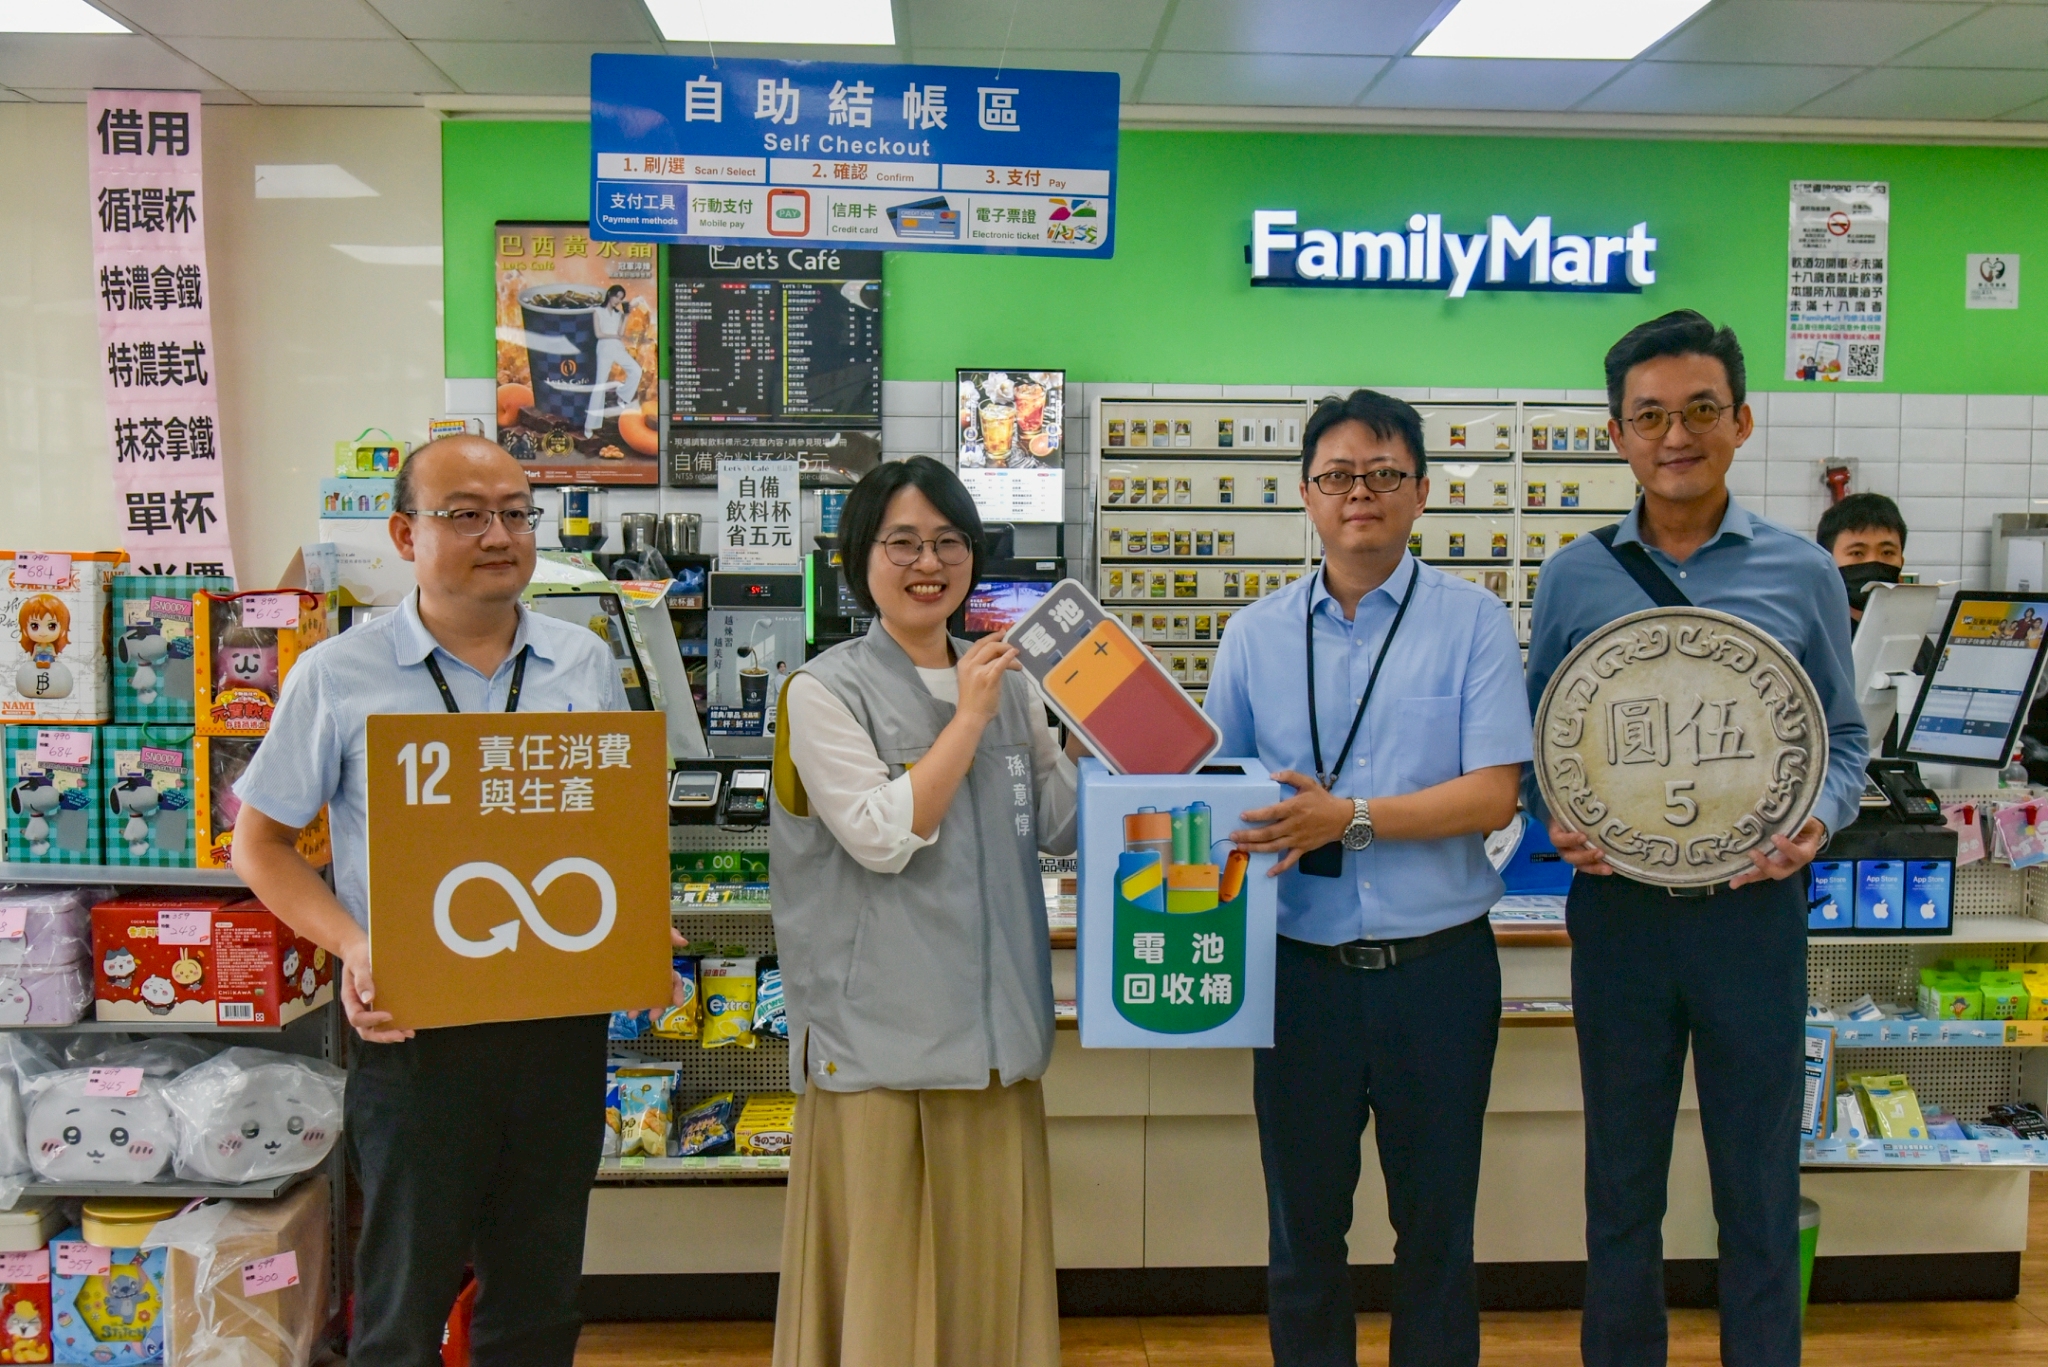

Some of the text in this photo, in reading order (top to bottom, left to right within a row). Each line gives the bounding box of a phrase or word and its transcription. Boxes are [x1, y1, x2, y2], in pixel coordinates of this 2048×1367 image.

[684, 74, 1021, 132] 自助結帳區
[96, 108, 190, 157] 借用
[763, 132, 930, 157] Self Checkout
[623, 157, 638, 172] 1.
[694, 165, 719, 176] Scan
[726, 166, 756, 177] Select
[811, 162, 915, 183] 2. 確認 Confirm
[985, 169, 1067, 190] 3. 支付 Pay
[98, 187, 197, 234] 循環杯
[609, 192, 676, 211] 支付工具
[691, 197, 754, 215] 行動支付
[831, 202, 878, 219] 信用卡
[602, 214, 679, 226] Payment methods
[699, 219, 745, 230] Mobile pay
[778, 209, 799, 218] PAY
[976, 207, 1037, 225] 電子票證
[831, 225, 879, 234] Credit card
[972, 229, 1040, 241] Electronic ticket
[500, 234, 652, 258] 巴西黃水晶
[1251, 209, 1658, 299] FamilyMart
[709, 244, 841, 271] Let's Café
[101, 264, 203, 312] 特濃拿鐵
[108, 341, 208, 388] 特濃美式
[115, 416, 216, 464] 抹茶拿鐵
[739, 475, 780, 498] 自備
[126, 490, 217, 536] 單杯
[726, 500, 792, 523] 飲料杯
[726, 524, 792, 547] 省五元
[27, 565, 54, 579] 684
[154, 600, 188, 613] SNOOPY
[256, 608, 284, 620] 615
[1019, 597, 1085, 657] 電池
[2, 701, 35, 712] NAMI
[54, 732, 71, 740] 990
[49, 747, 73, 757] 684
[144, 751, 178, 764] SNOOPY
[478, 733, 632, 773] 責任消費
[397, 741, 451, 805] 12
[480, 776, 595, 816] 與生產
[1005, 754, 1031, 836] 孫意惇
[1663, 779, 1699, 826] 5
[170, 925, 198, 937] 248
[1132, 932, 1225, 964] 電池
[1123, 972, 1233, 1006] 回收桶
[709, 998, 751, 1013] extra
[256, 1273, 279, 1286] 300
